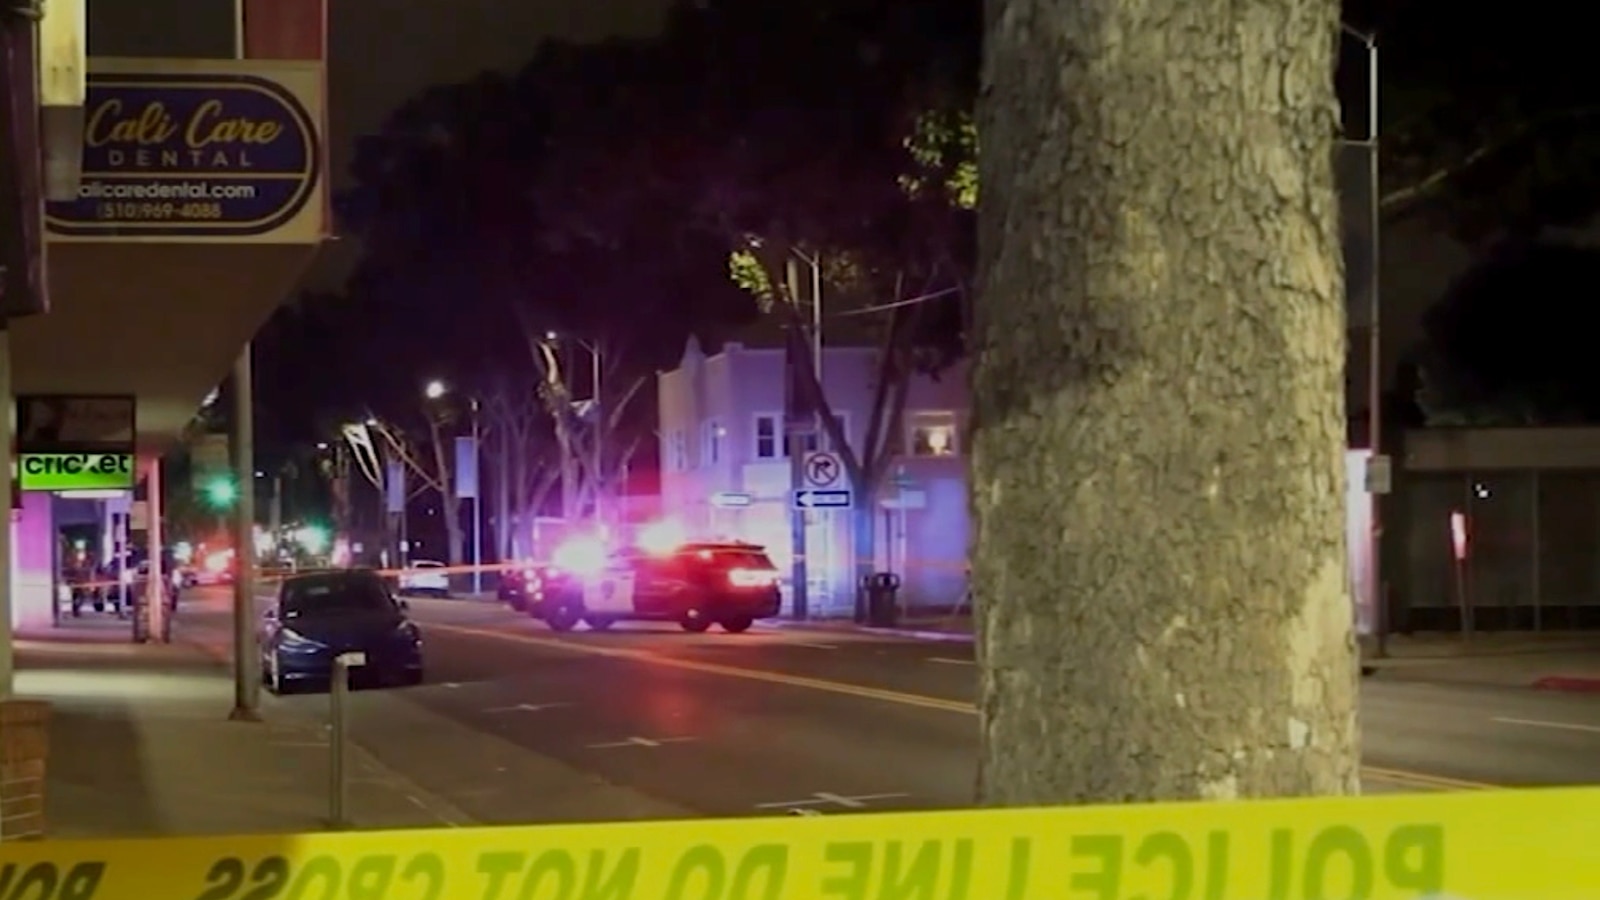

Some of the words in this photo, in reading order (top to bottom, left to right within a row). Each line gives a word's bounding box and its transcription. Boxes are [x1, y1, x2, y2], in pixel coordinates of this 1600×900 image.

[86, 98, 177, 147] Cali
[185, 99, 283, 148] Care
[109, 151, 253, 167] DENTAL
[79, 182, 256, 198] alicaredental.com
